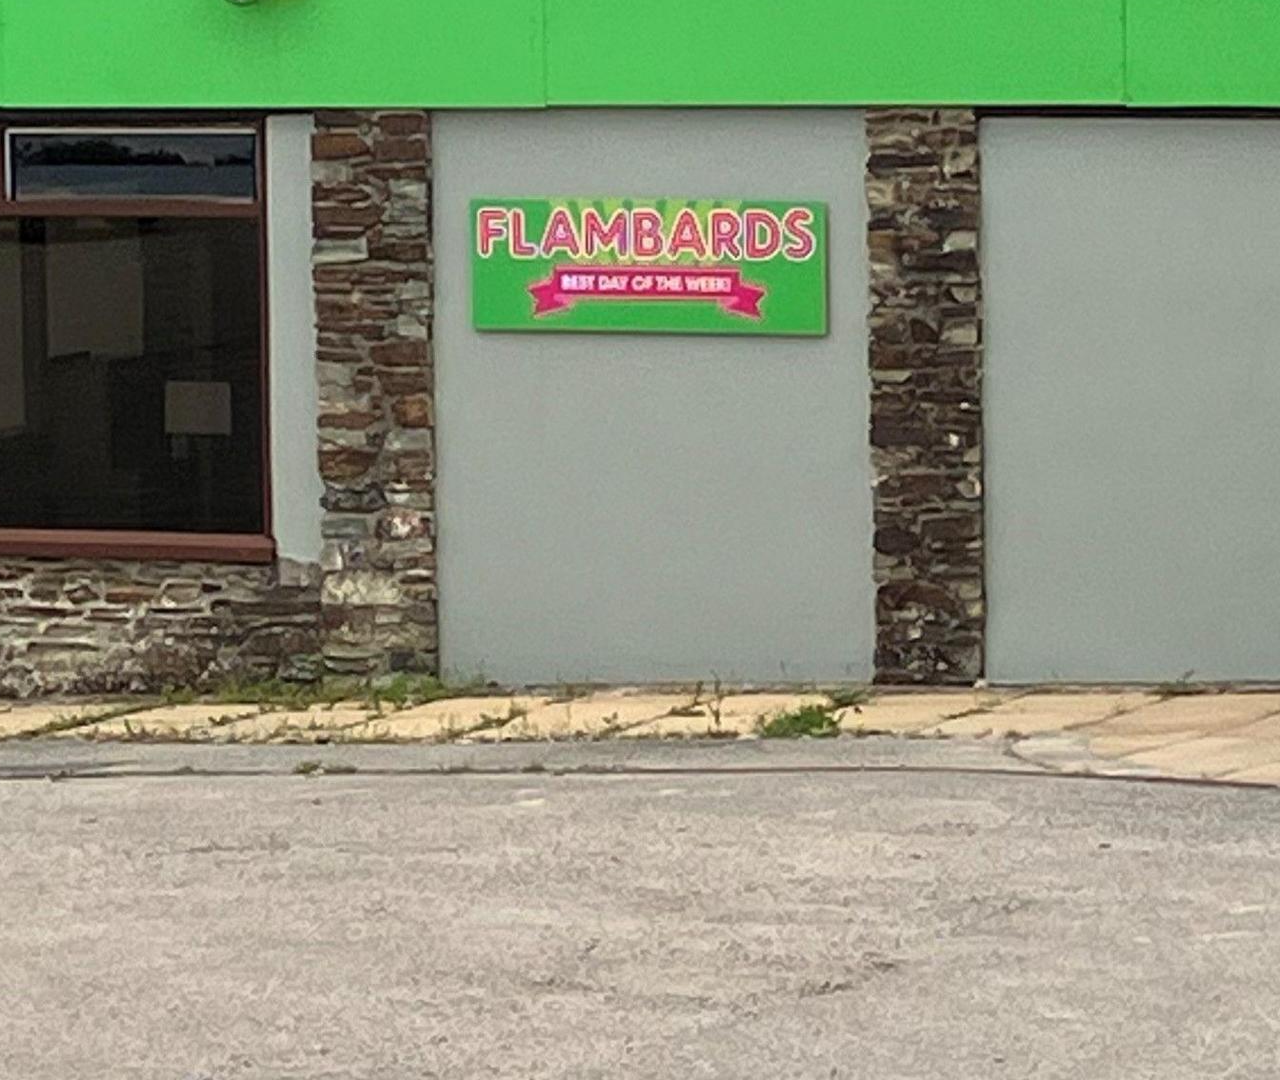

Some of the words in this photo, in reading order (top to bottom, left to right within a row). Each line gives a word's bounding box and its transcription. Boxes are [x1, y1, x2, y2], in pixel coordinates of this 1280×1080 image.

[476, 207, 816, 261] FLAMBARDS
[560, 274, 596, 291] BEST
[598, 274, 630, 291] DAY
[631, 274, 654, 292] OF
[655, 275, 684, 292] THE
